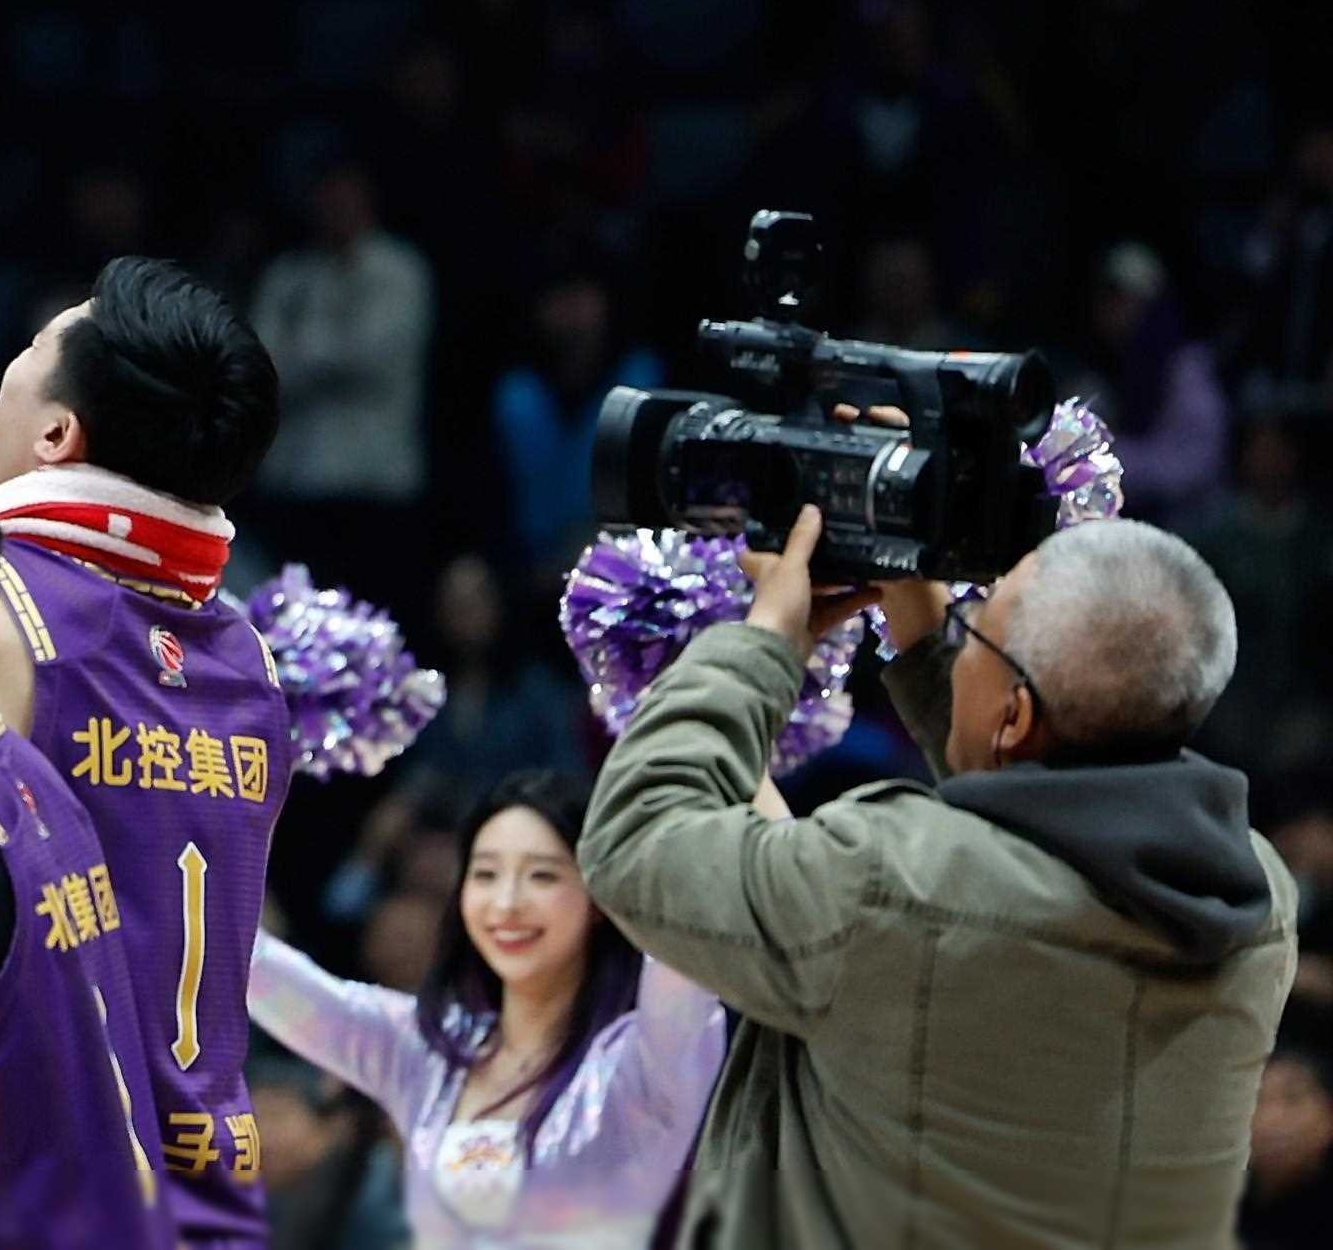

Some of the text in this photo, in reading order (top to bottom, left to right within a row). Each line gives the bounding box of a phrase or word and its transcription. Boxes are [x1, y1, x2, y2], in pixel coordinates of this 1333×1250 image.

[72, 717, 268, 803] 北控集团
[170, 841, 208, 1072] 1
